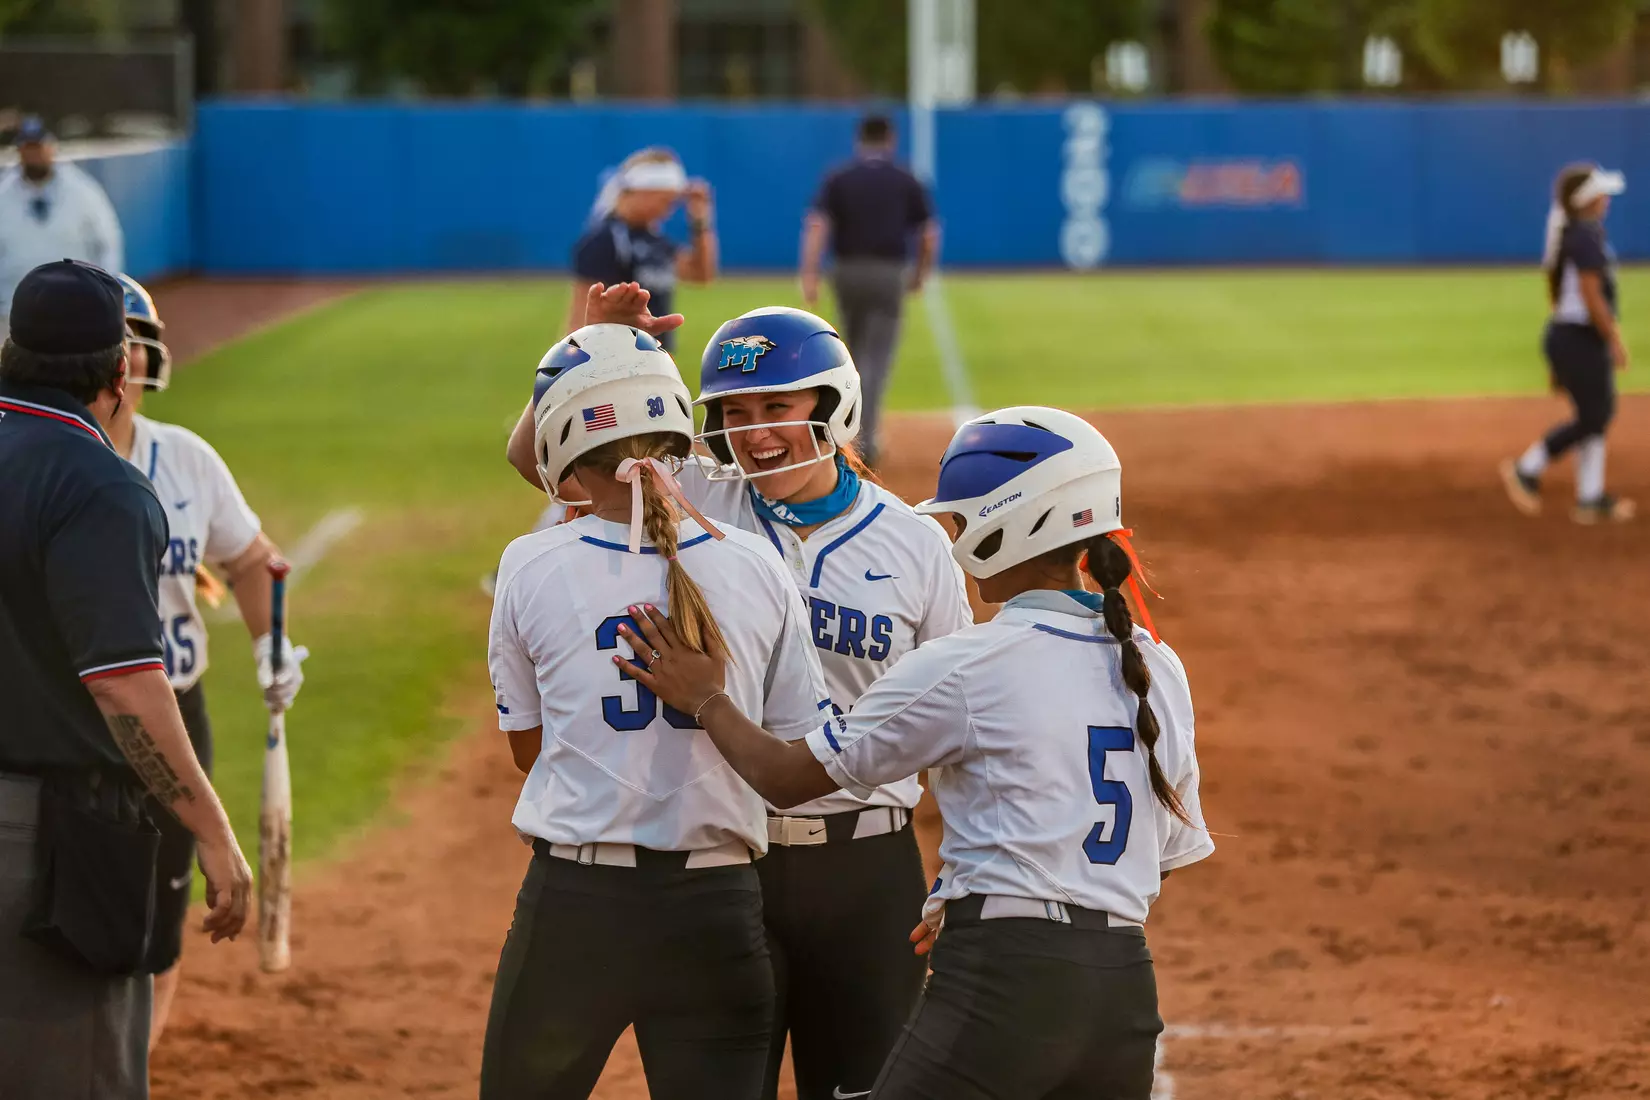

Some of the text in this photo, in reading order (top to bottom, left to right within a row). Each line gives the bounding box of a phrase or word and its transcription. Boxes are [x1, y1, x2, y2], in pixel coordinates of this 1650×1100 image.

[718, 341, 765, 373] MT
[646, 396, 665, 419] 30
[986, 491, 1022, 515] EASTON
[160, 536, 198, 576] RS
[801, 594, 893, 662] ERS
[595, 614, 706, 732] 3
[1082, 725, 1135, 866] 5
